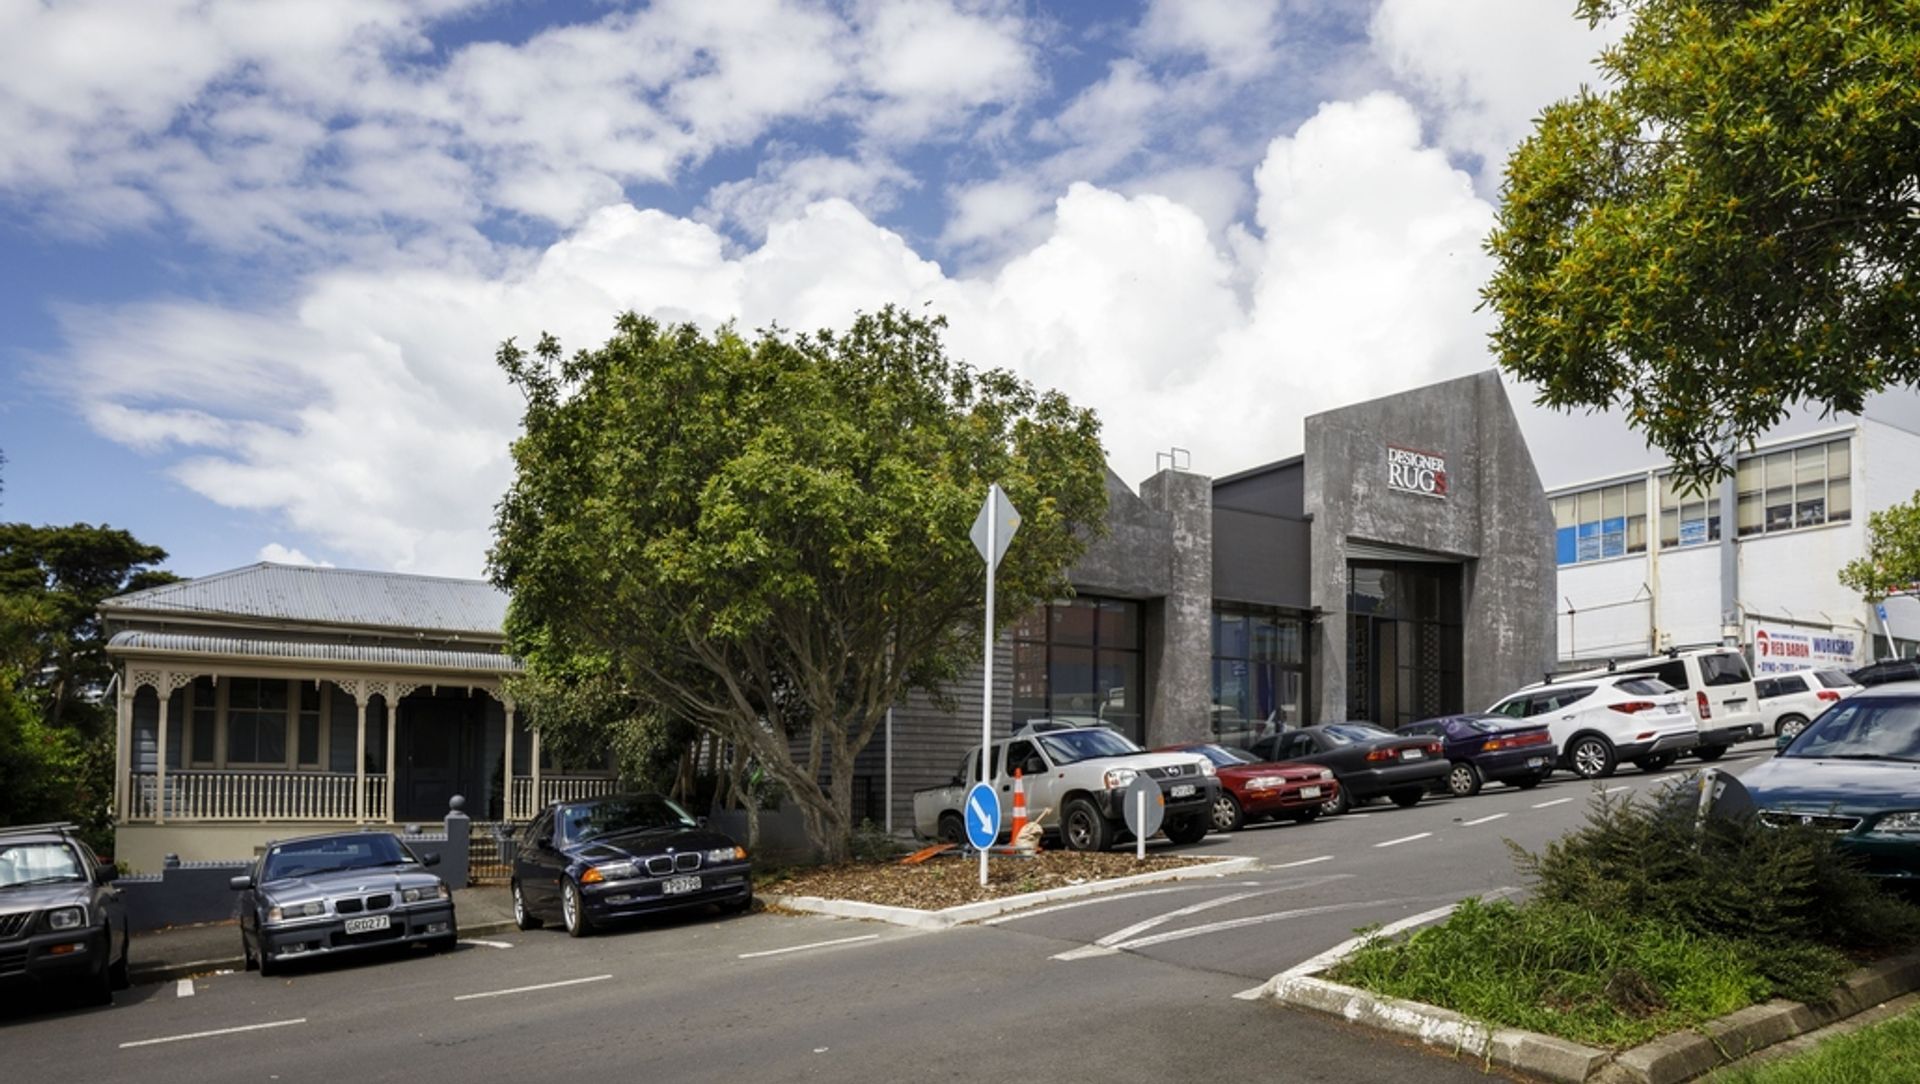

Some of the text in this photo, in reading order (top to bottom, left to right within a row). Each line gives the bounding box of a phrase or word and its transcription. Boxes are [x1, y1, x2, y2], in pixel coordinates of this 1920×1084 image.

[1388, 448, 1446, 472] DESIGNER
[1388, 462, 1448, 495] RUGS
[1771, 641, 1785, 656] RED
[1813, 638, 1855, 656] WORKSHOP
